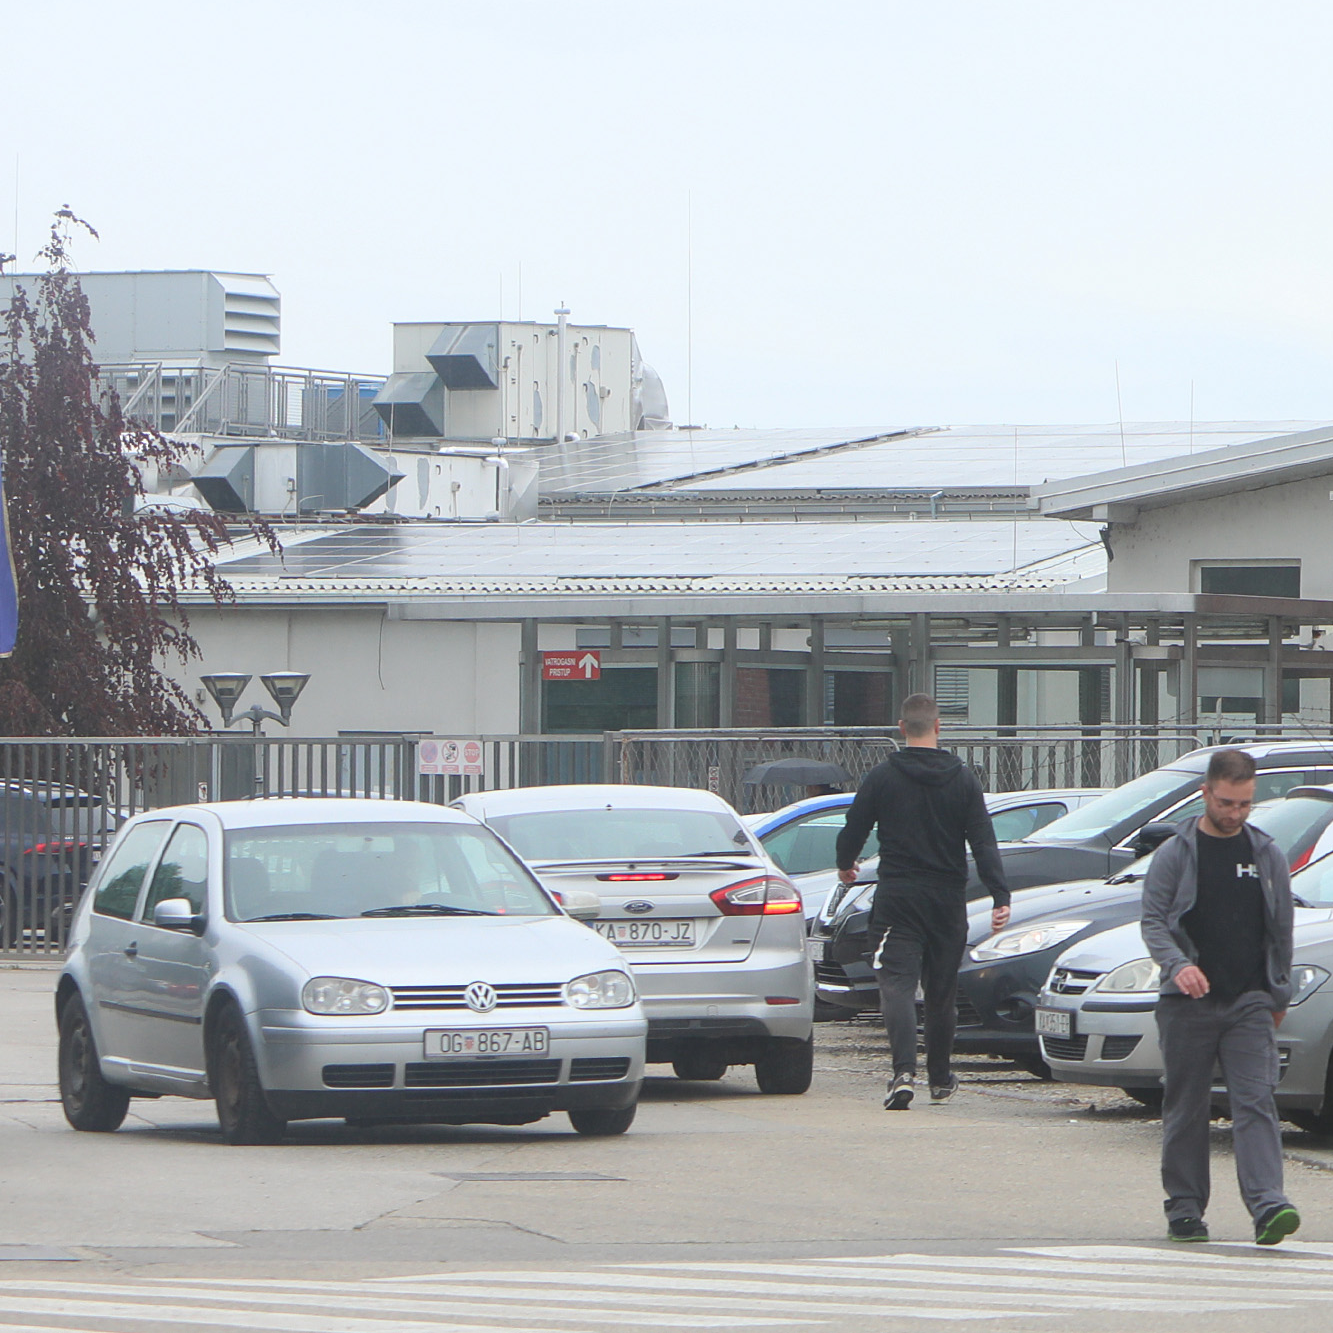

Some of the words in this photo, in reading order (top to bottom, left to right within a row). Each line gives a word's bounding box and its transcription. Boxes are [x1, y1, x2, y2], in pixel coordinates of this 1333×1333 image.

[549, 668, 571, 677] PRISTUP
[595, 923, 617, 940] KA
[629, 922, 691, 940] 870-JZ
[440, 1033, 463, 1053] OG
[478, 1031, 545, 1053] 867-AB
